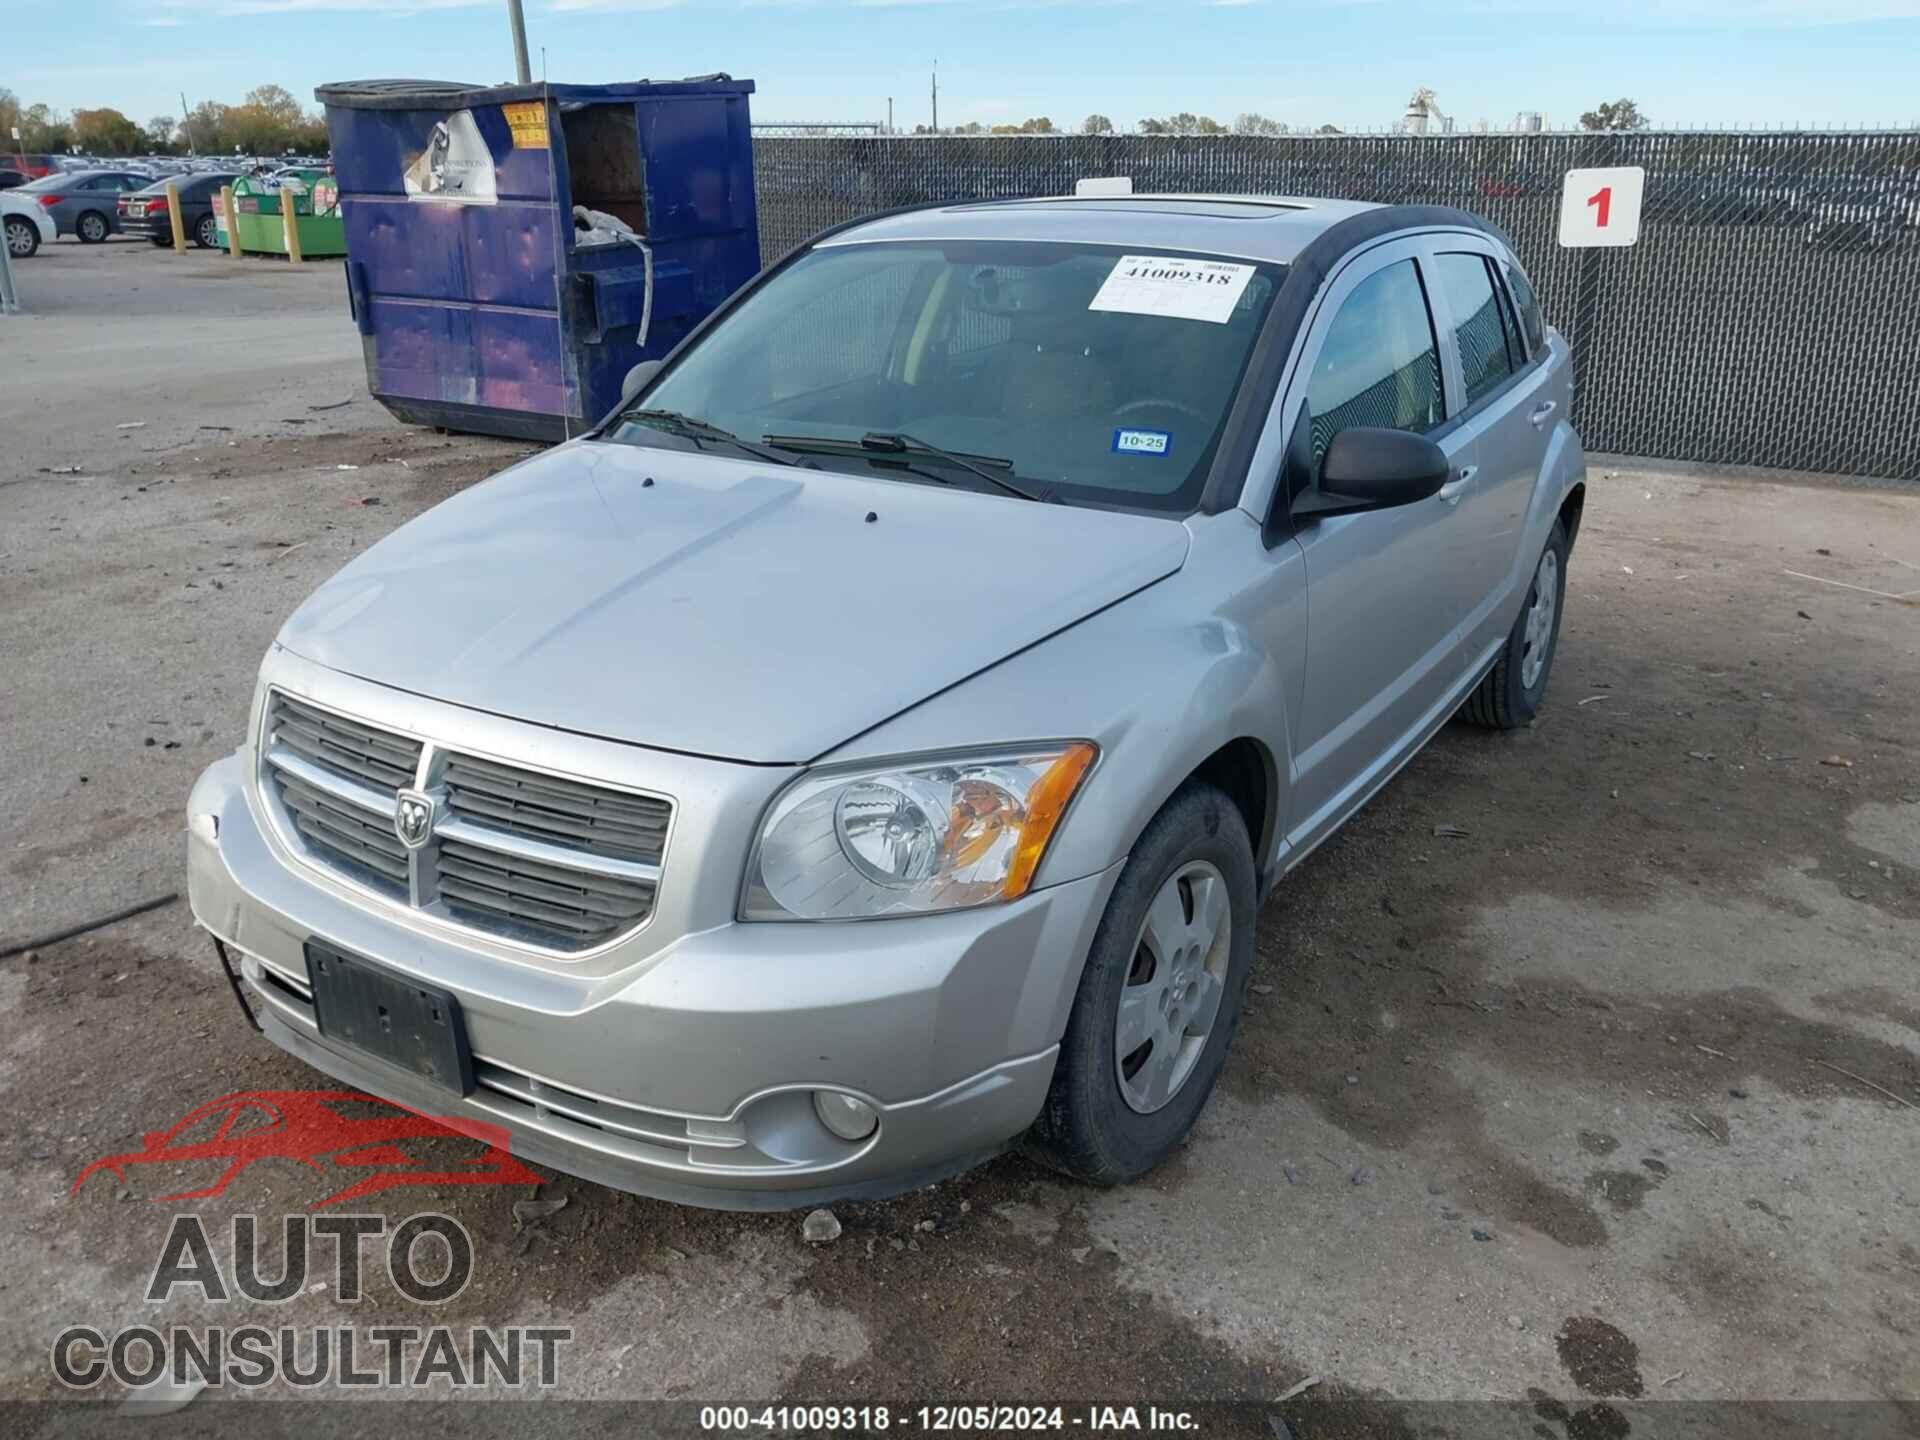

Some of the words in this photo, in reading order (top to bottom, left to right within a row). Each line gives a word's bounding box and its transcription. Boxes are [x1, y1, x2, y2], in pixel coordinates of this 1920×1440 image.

[1587, 187, 1612, 228] 1
[1125, 267, 1232, 285] 41009318
[1123, 435, 1164, 448] 10-25
